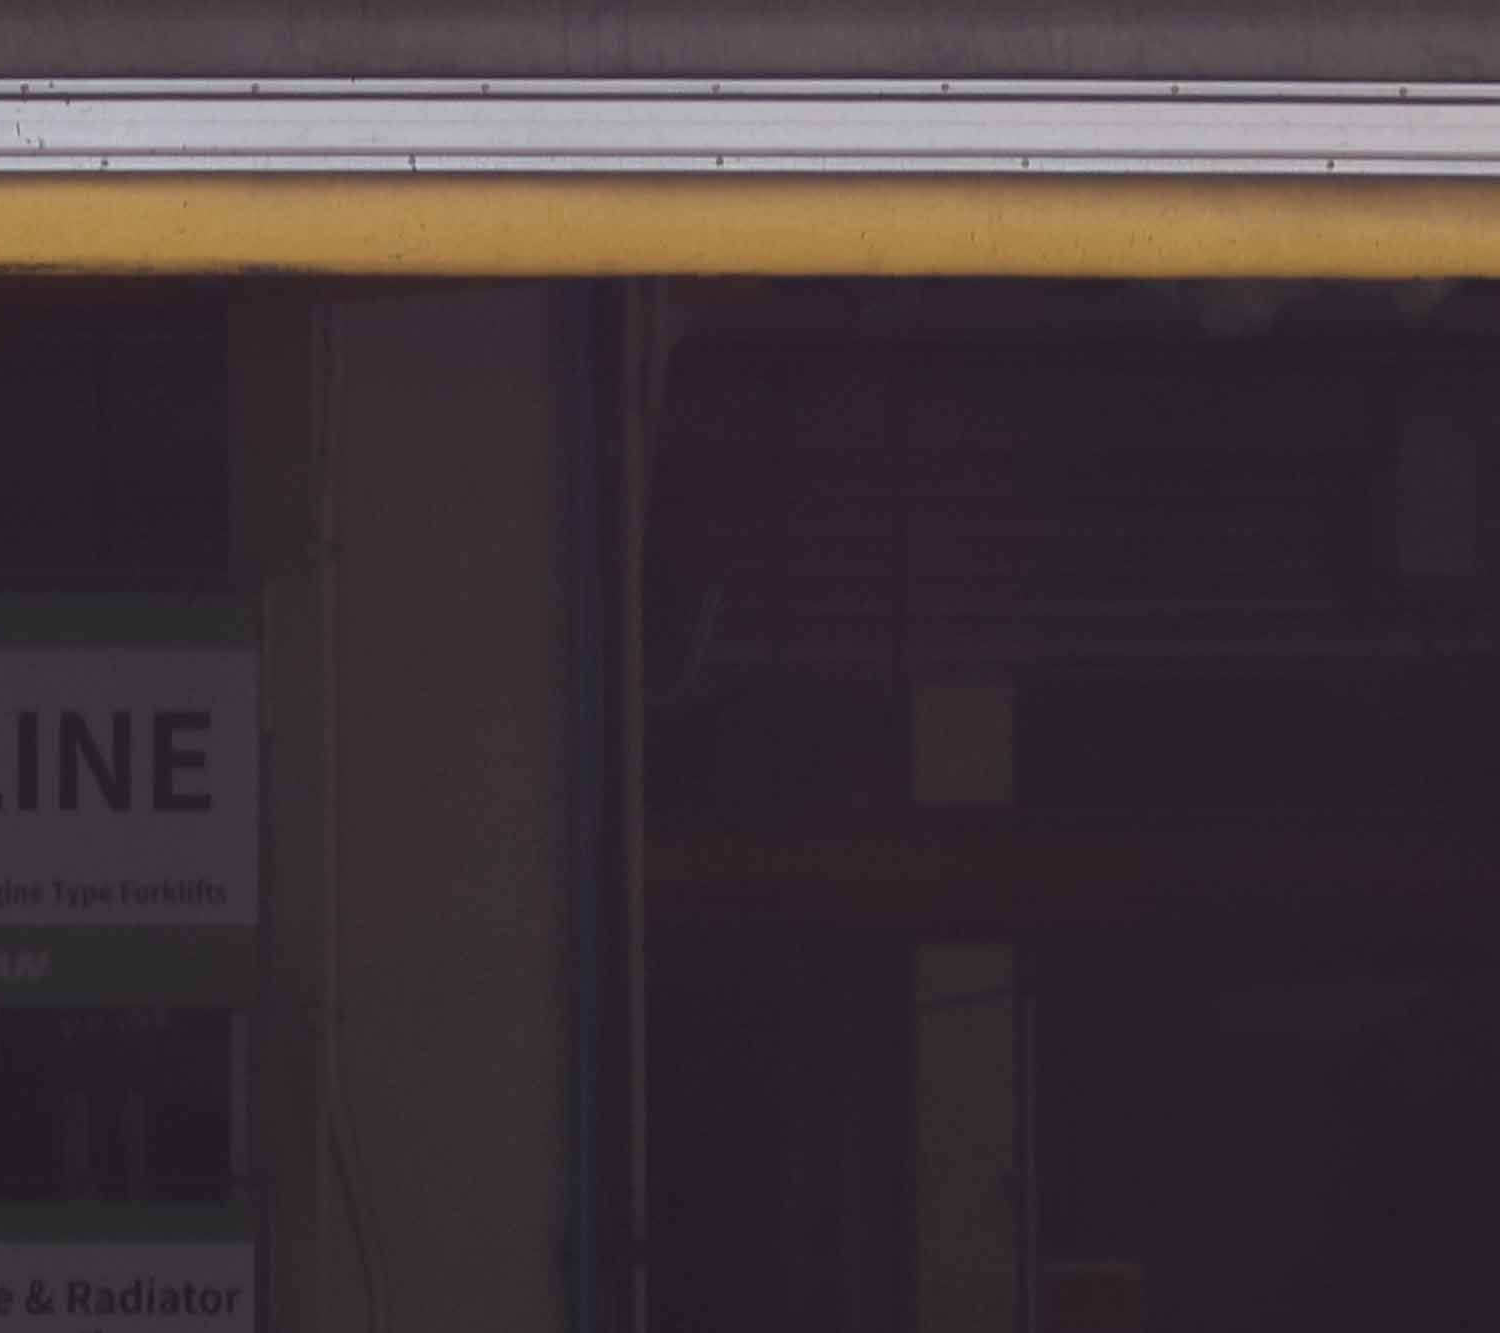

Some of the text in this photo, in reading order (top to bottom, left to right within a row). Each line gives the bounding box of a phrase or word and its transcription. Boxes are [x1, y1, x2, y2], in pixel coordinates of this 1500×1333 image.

[51, 878, 114, 910] Type
[120, 877, 228, 906] Forklifts
[24, 1279, 54, 1315] &
[67, 1278, 243, 1315] Radiator
